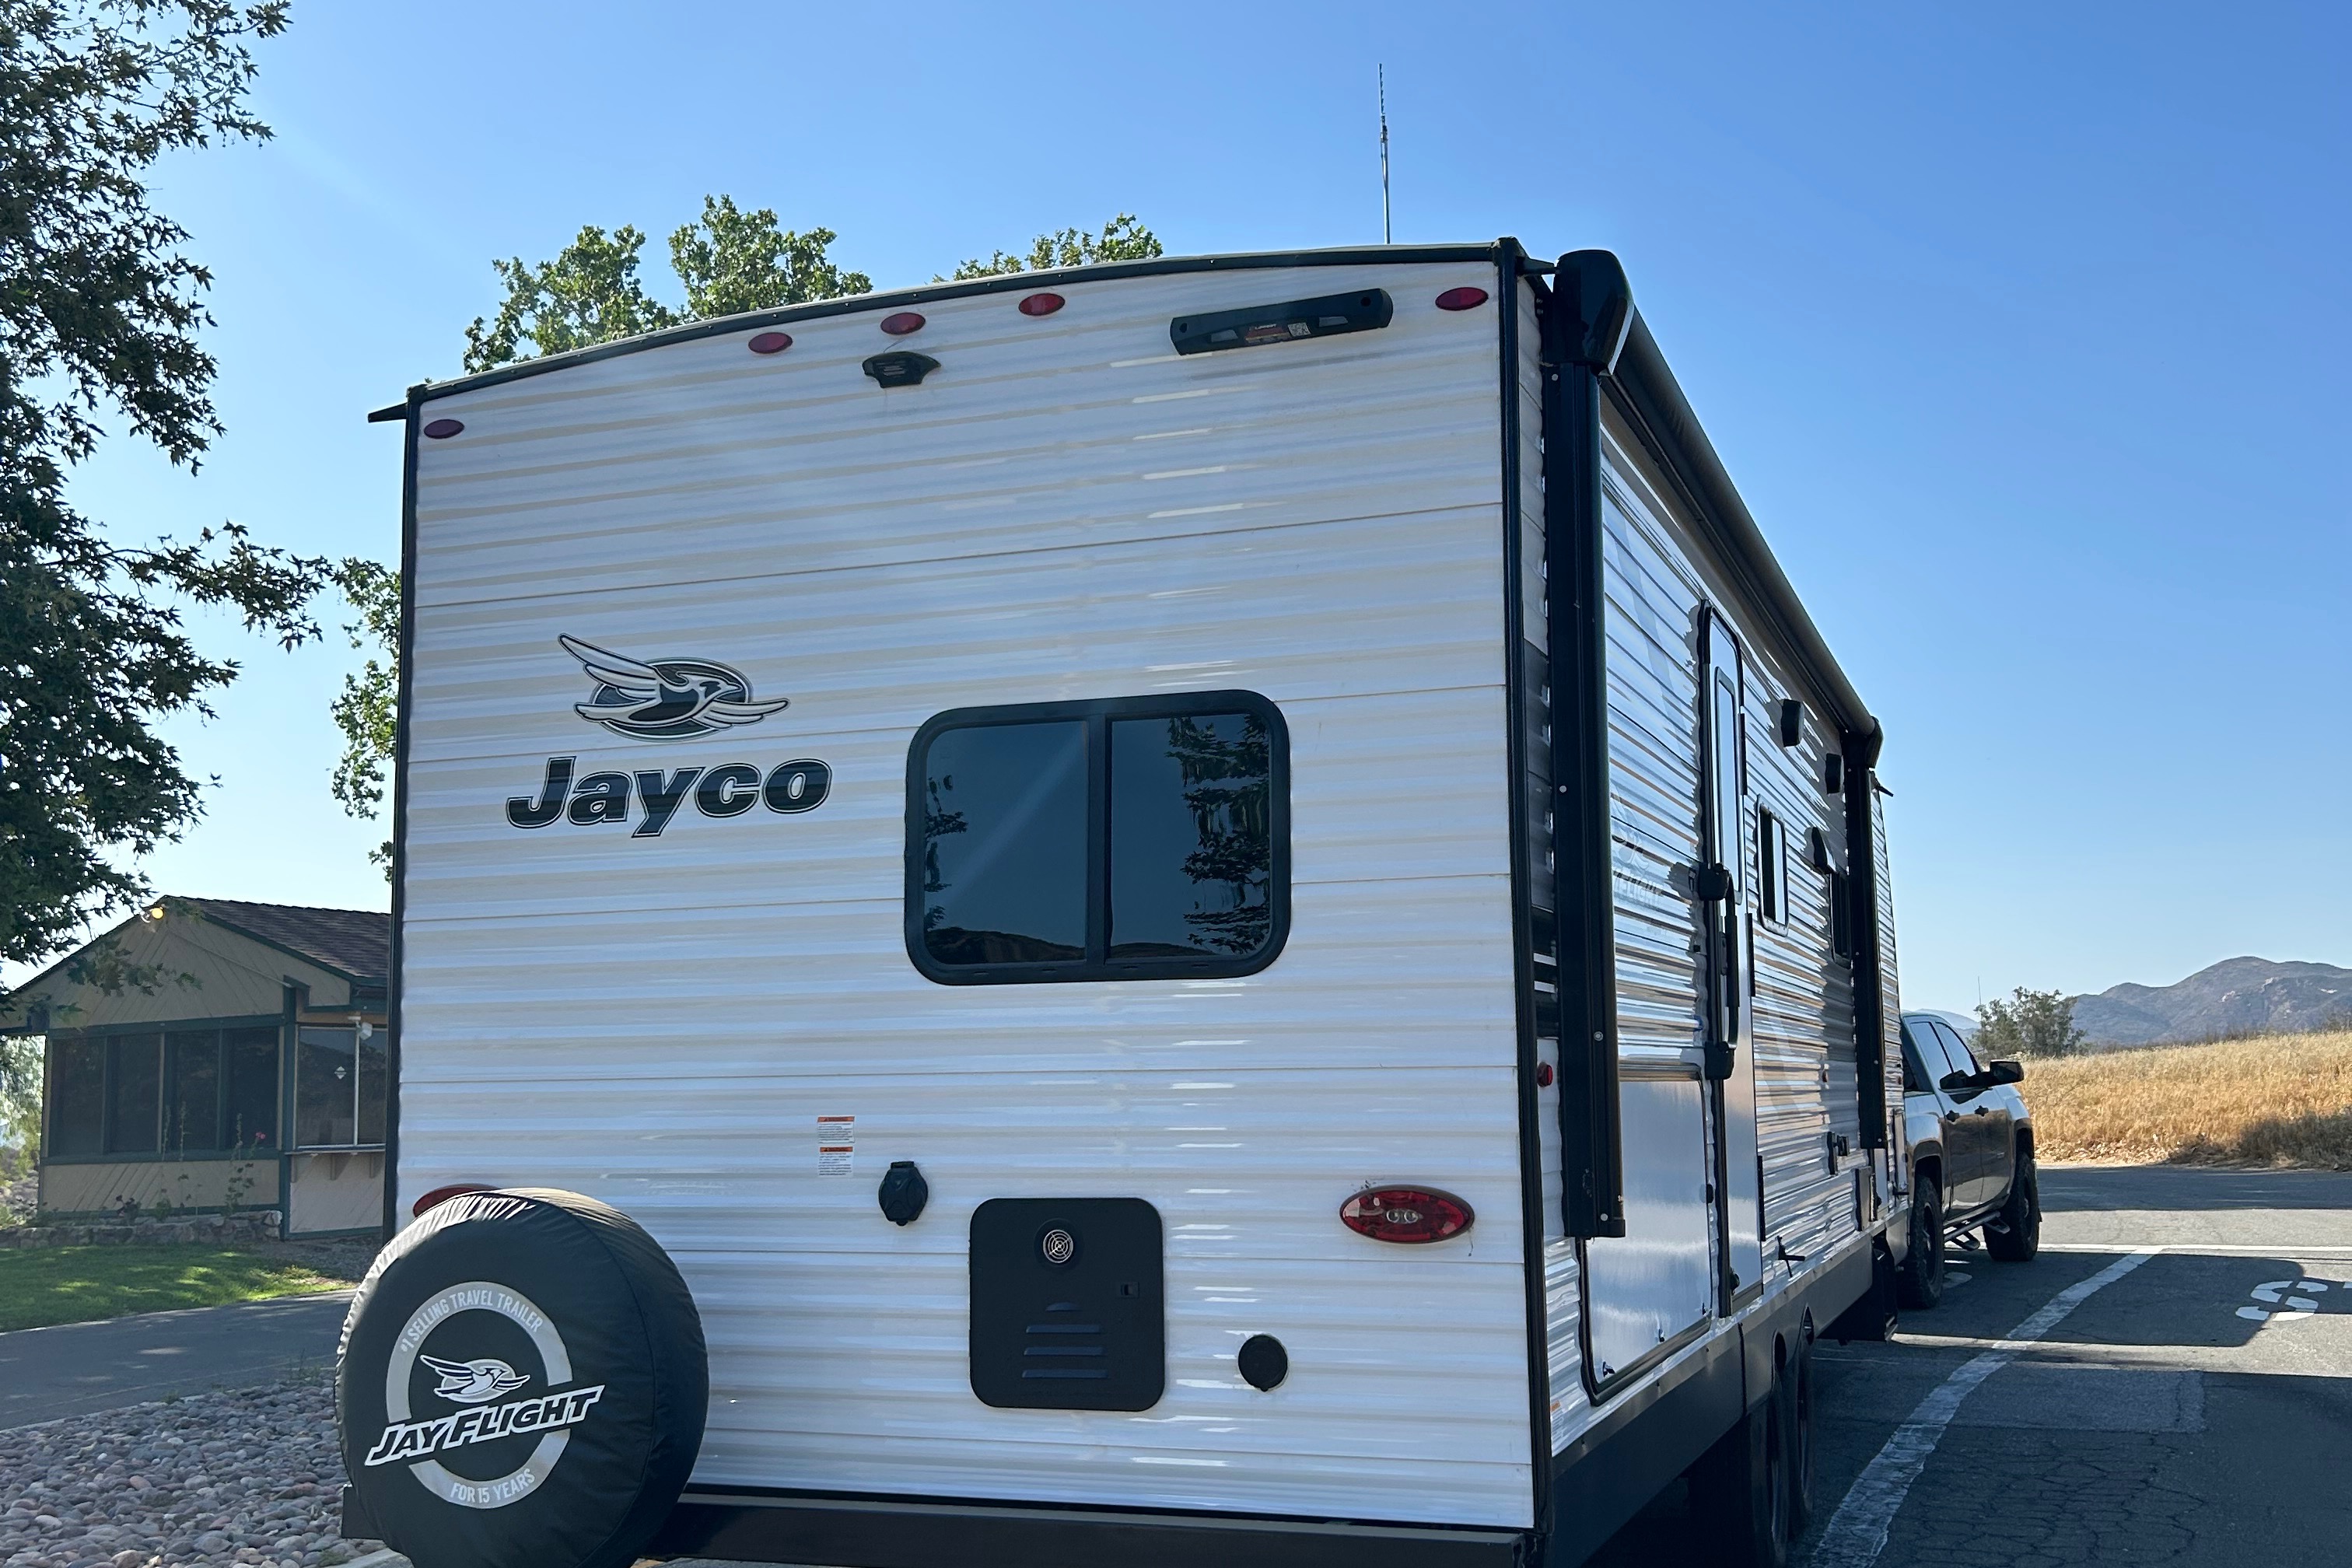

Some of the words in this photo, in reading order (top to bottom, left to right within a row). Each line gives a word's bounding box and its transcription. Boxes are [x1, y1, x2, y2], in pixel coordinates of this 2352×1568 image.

[506, 755, 833, 838] Jayco
[408, 1299, 450, 1342] SELLING
[450, 1290, 493, 1310] TRAVEL
[497, 1293, 544, 1332] TRAILER
[450, 1482, 475, 1503] FOR
[478, 1486, 490, 1503] 15
[493, 1468, 535, 1501] YEARS
